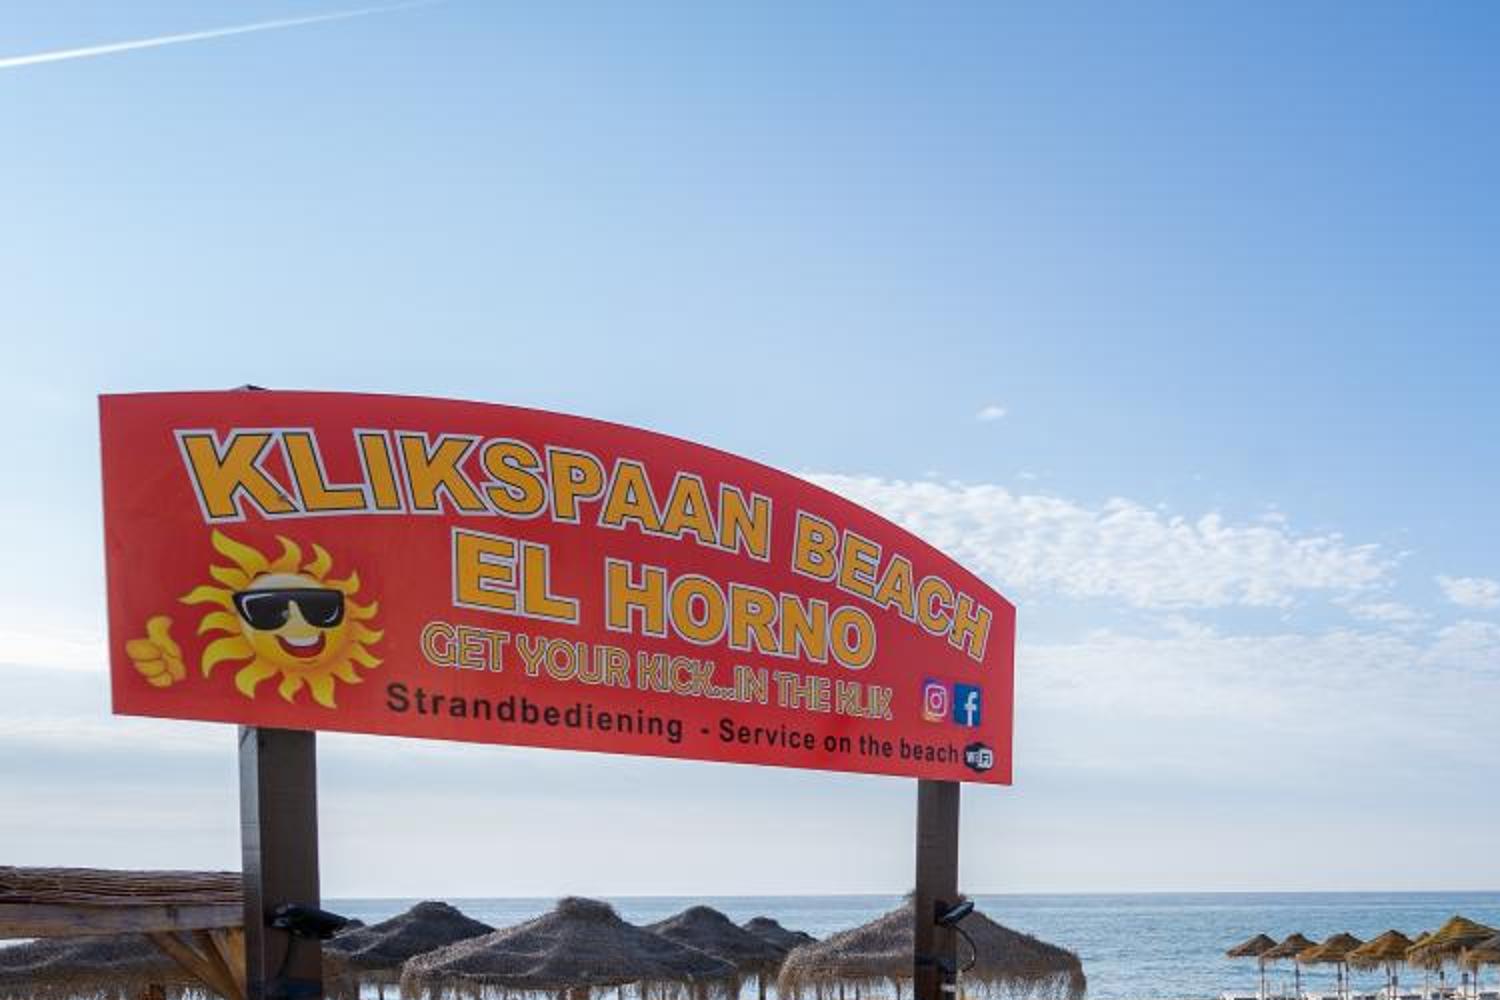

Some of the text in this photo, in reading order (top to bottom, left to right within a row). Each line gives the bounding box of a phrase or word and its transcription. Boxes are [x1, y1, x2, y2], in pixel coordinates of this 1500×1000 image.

[173, 427, 993, 663] KLIKSPAAN BEACH
[451, 526, 877, 670] EL HORNO
[387, 682, 683, 744] Strandbediening
[718, 717, 815, 751] Service
[823, 738, 851, 754] on
[860, 737, 893, 758] the
[900, 739, 959, 764] beach
[421, 621, 510, 673] GET
[515, 633, 630, 688] YOUR
[772, 671, 832, 713] THE
[836, 679, 894, 721] KLIK
